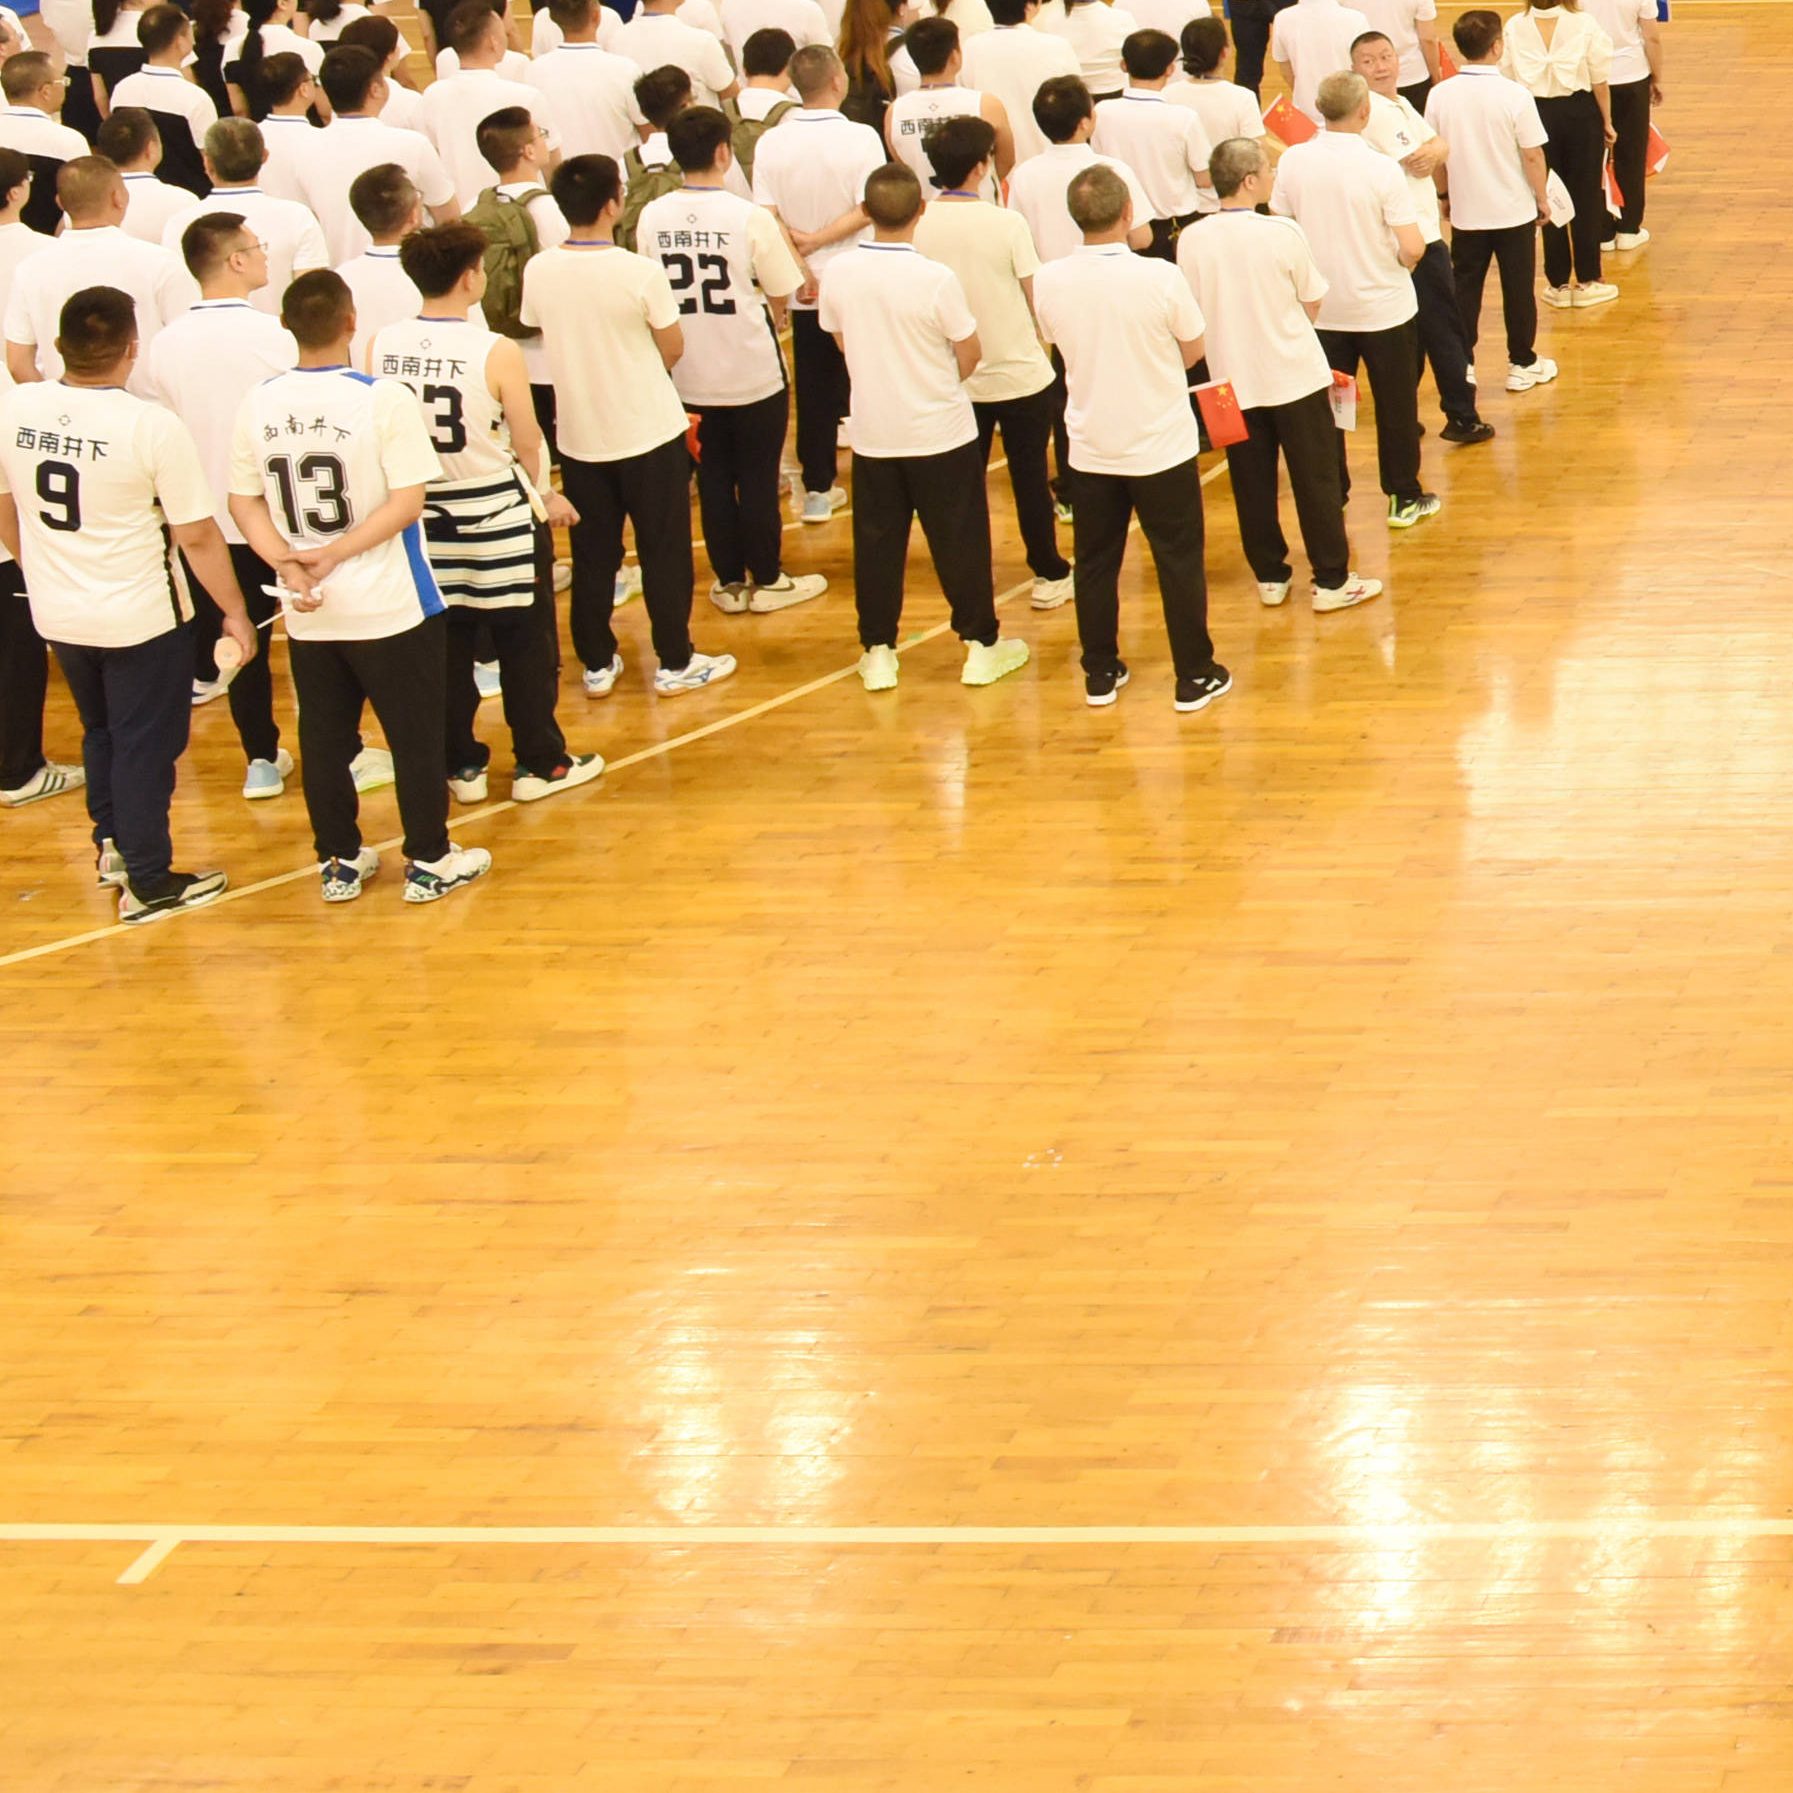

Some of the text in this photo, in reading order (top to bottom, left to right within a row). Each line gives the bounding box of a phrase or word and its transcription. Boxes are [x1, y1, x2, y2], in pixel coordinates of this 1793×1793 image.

[657, 231, 731, 249] 西南井下
[661, 253, 736, 315] 22
[382, 354, 467, 379] 西南井下
[16, 427, 109, 461] 西南井下
[36, 459, 80, 532] 9
[264, 452, 354, 537] 13
